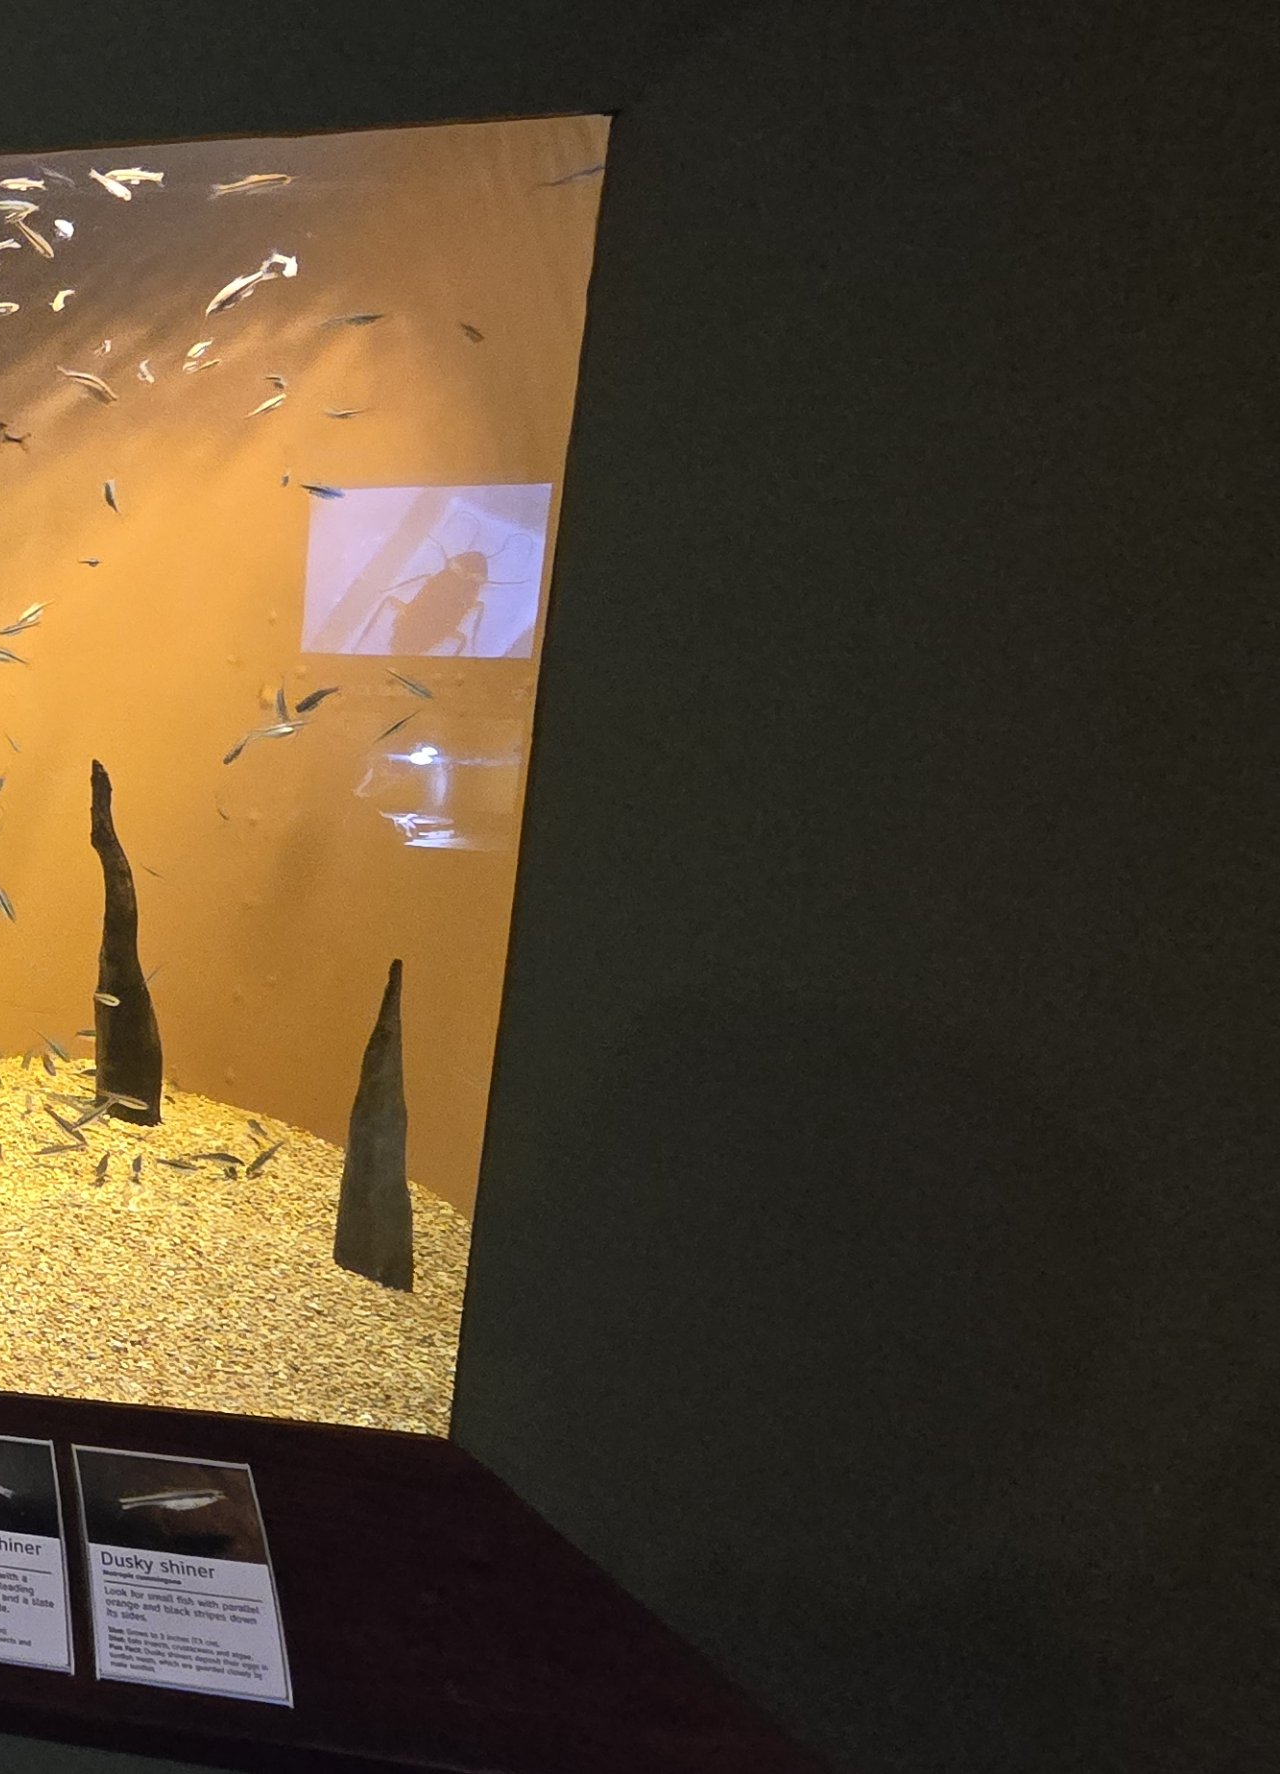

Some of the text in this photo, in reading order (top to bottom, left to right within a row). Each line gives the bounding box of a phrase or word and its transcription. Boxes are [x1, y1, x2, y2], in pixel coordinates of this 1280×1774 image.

[101, 1552, 154, 1575] Dusky
[160, 1560, 215, 1579] shiner
[0, 1573, 19, 1581] with
[22, 1576, 28, 1584] a
[0, 1583, 35, 1597] leading
[2, 1595, 20, 1604] and
[104, 1586, 128, 1597] Look
[131, 1590, 145, 1599] for
[148, 1594, 174, 1603] small
[177, 1596, 195, 1606] fish
[198, 1601, 219, 1609] with
[106, 1599, 258, 1625] orange and black stripes down
[107, 1609, 119, 1619] its
